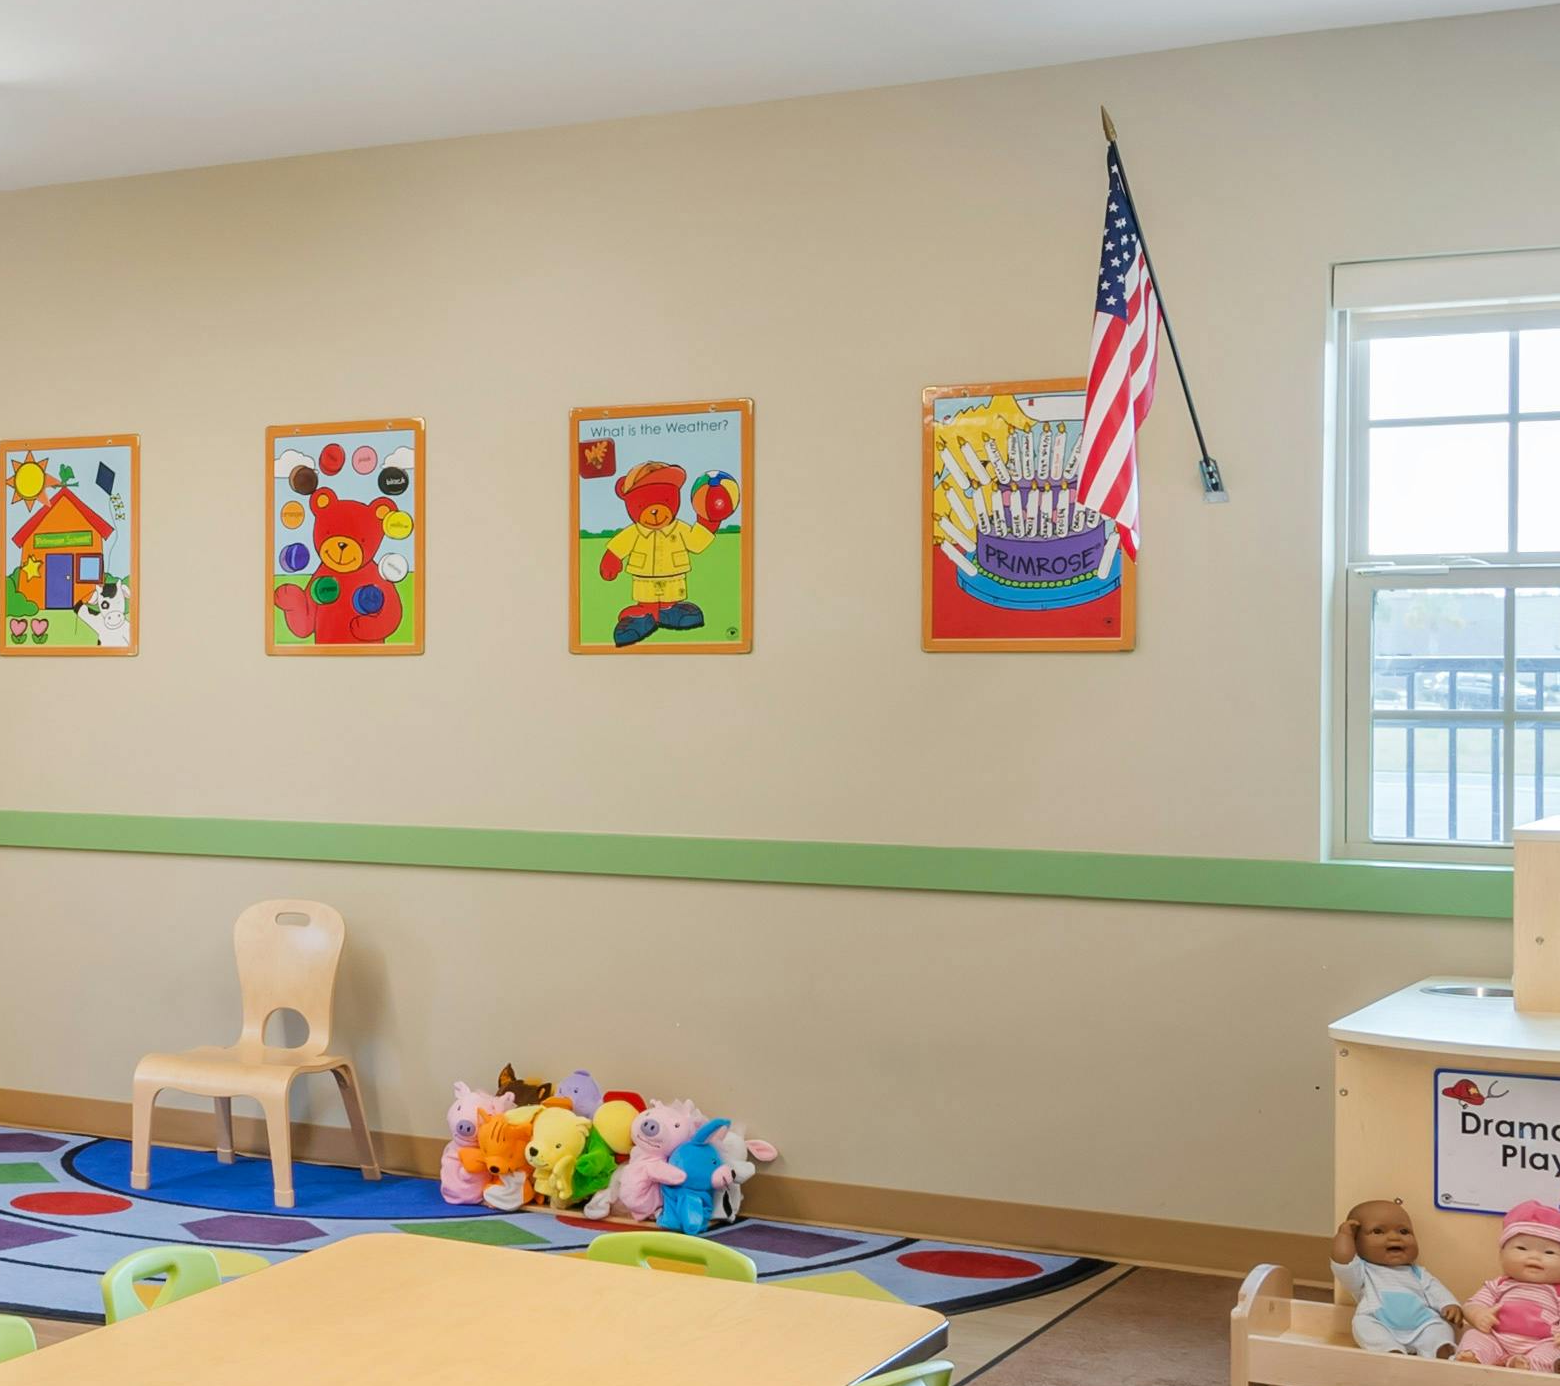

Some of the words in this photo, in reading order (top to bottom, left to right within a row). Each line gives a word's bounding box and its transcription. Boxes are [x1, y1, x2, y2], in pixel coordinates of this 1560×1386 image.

[590, 426, 624, 437] What
[628, 424, 636, 436] is
[640, 424, 661, 435] the
[665, 419, 729, 434] Weather?
[386, 477, 406, 486] black
[986, 543, 1097, 577] PRIMROSE
